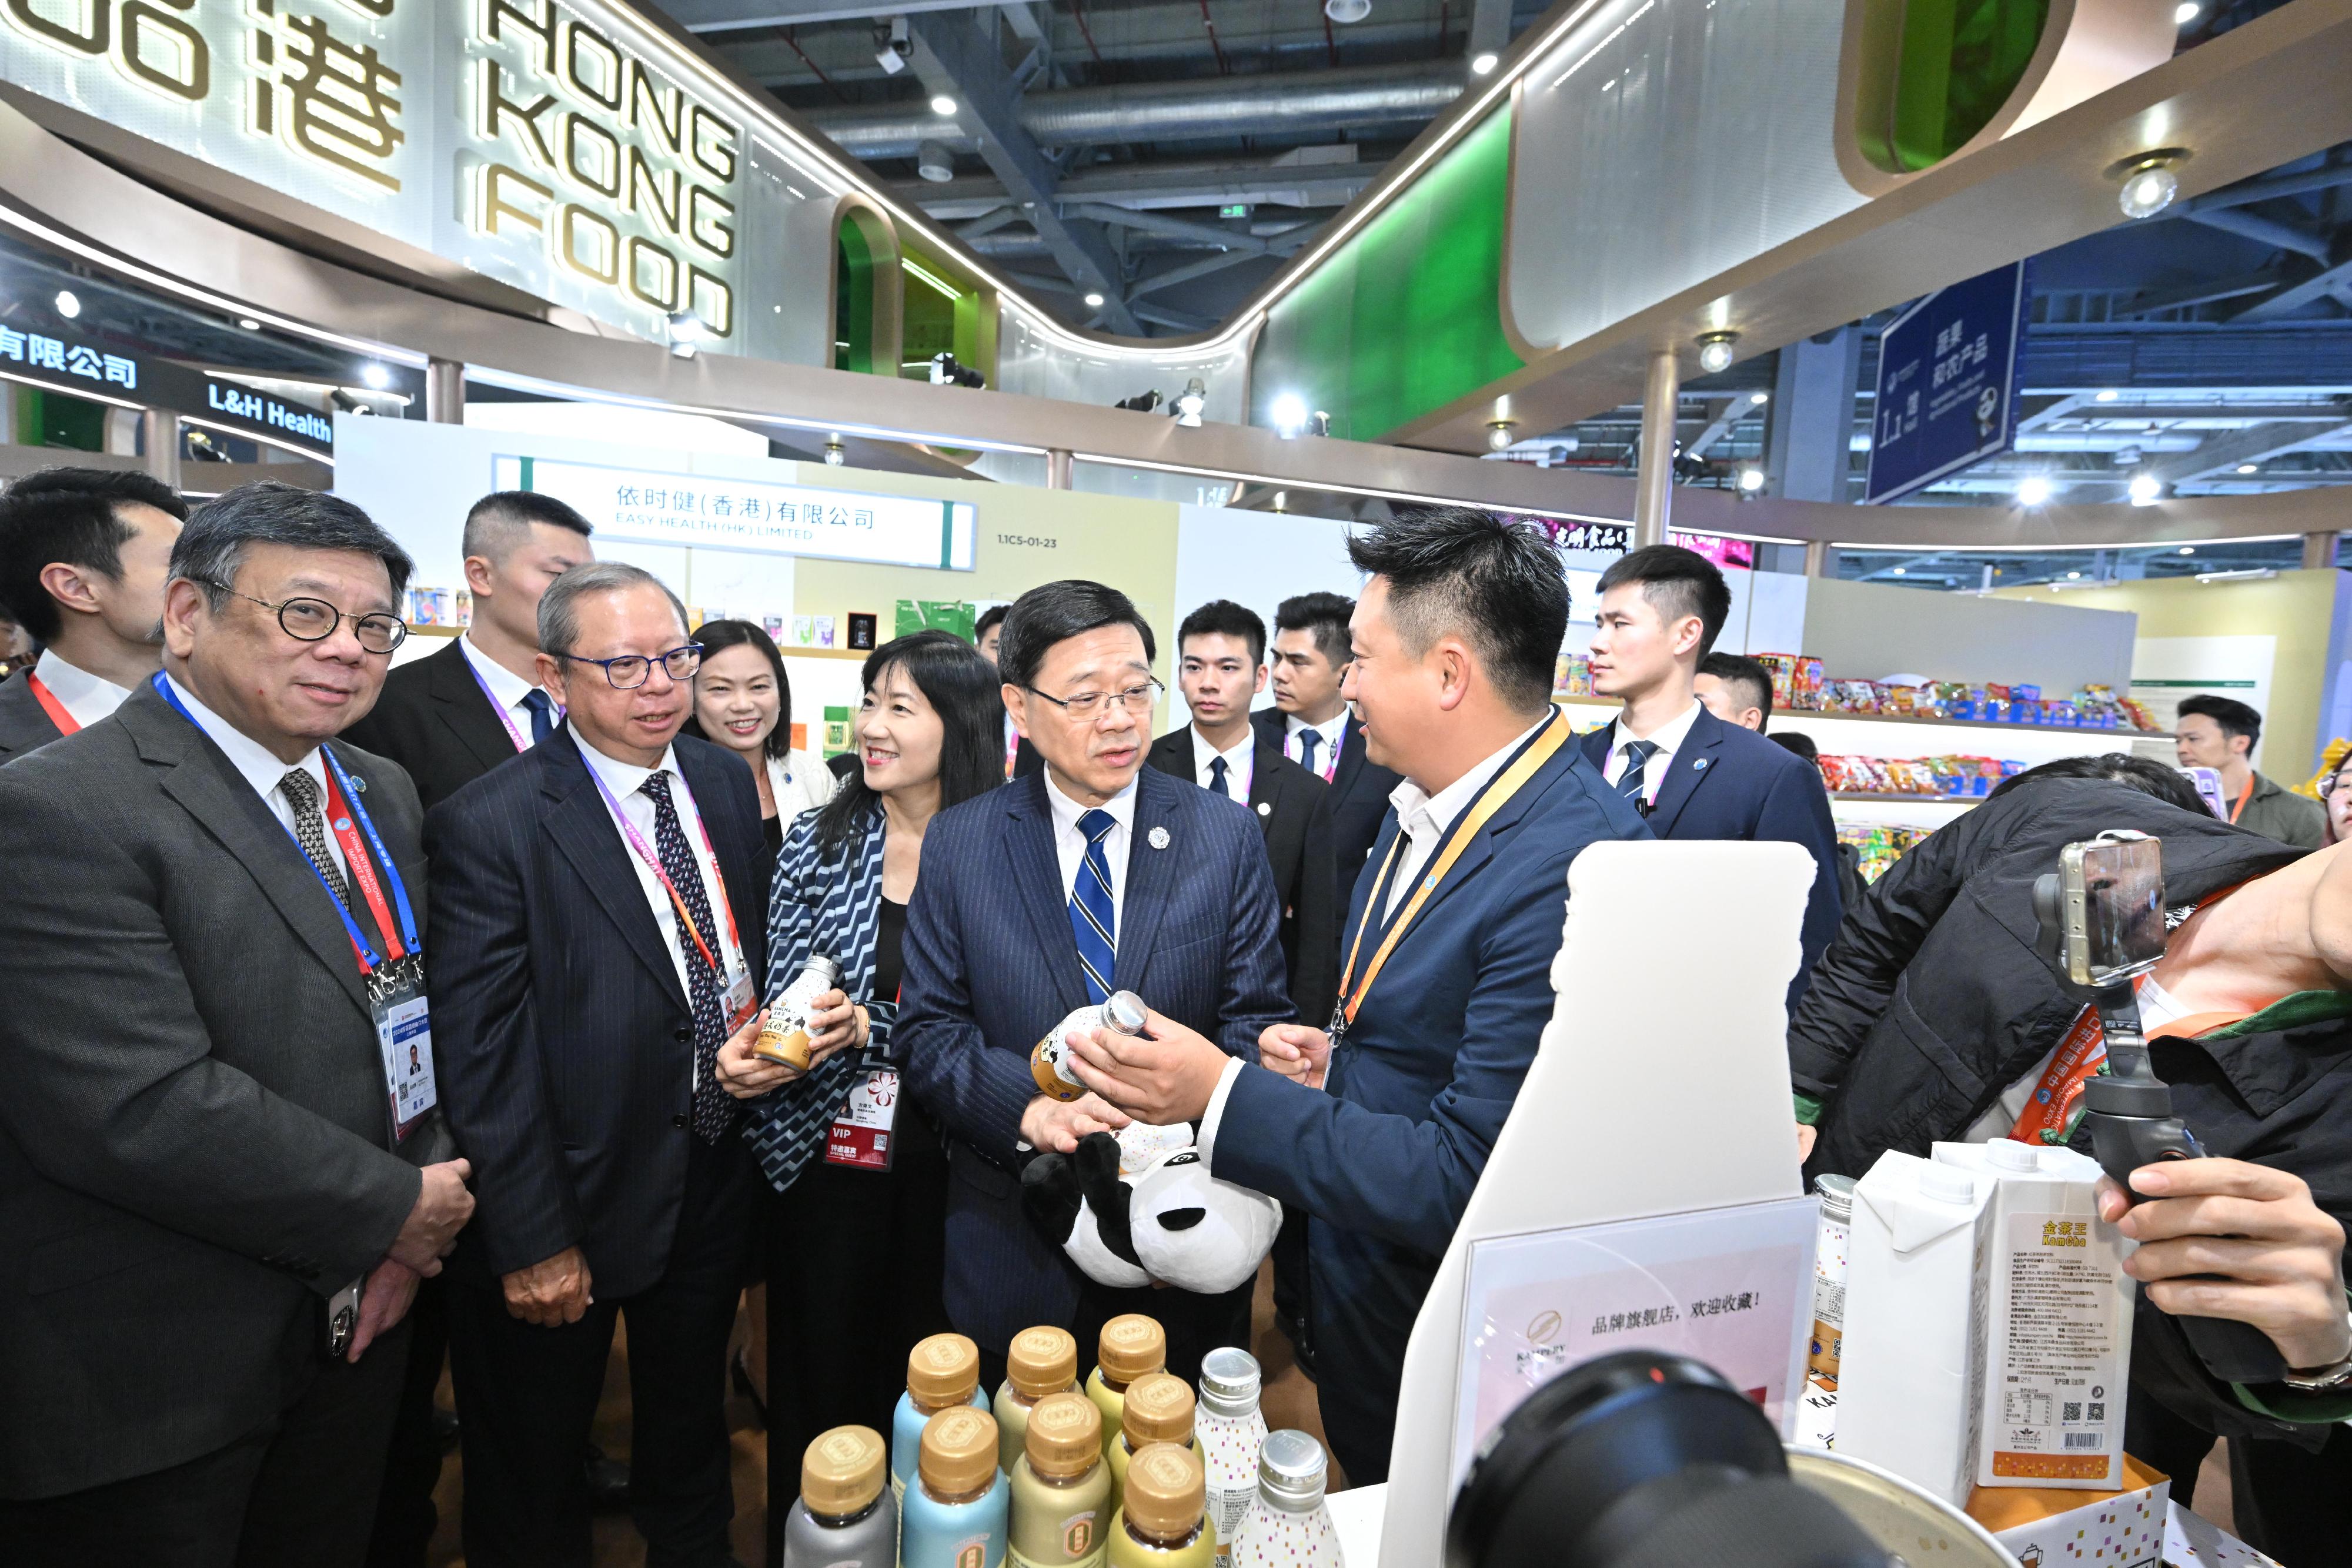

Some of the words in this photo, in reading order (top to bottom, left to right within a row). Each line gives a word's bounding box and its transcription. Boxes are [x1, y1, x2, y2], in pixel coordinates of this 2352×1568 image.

[246, 0, 404, 195] 港
[477, 0, 736, 186] HONG
[477, 57, 735, 262] KONG
[476, 163, 733, 338] FOOD
[0, 326, 136, 389] 有限公司
[209, 384, 263, 421] L&H
[268, 402, 332, 443] Health
[616, 484, 874, 529] 依时健(香港)有限公司
[616, 513, 654, 526] EASY
[660, 517, 717, 532] HEALTH
[722, 523, 753, 536] (HK)
[757, 526, 813, 540] LIMITED
[998, 534, 1057, 549] 1.1C5-01-23
[348, 831, 362, 855] CHINA
[358, 854, 385, 907] INTERNATIONAL
[348, 848, 364, 874] IMPORT
[360, 873, 372, 894] EXPO
[2047, 1015, 2101, 1088] 中国国际进口
[2056, 1075, 2079, 1102] IMPORT
[833, 1128, 851, 1139] VIP
[2043, 1104, 2057, 1125] EXPO
[2042, 1221, 2087, 1235] 金茶王
[2042, 1235, 2086, 1247] KamCha
